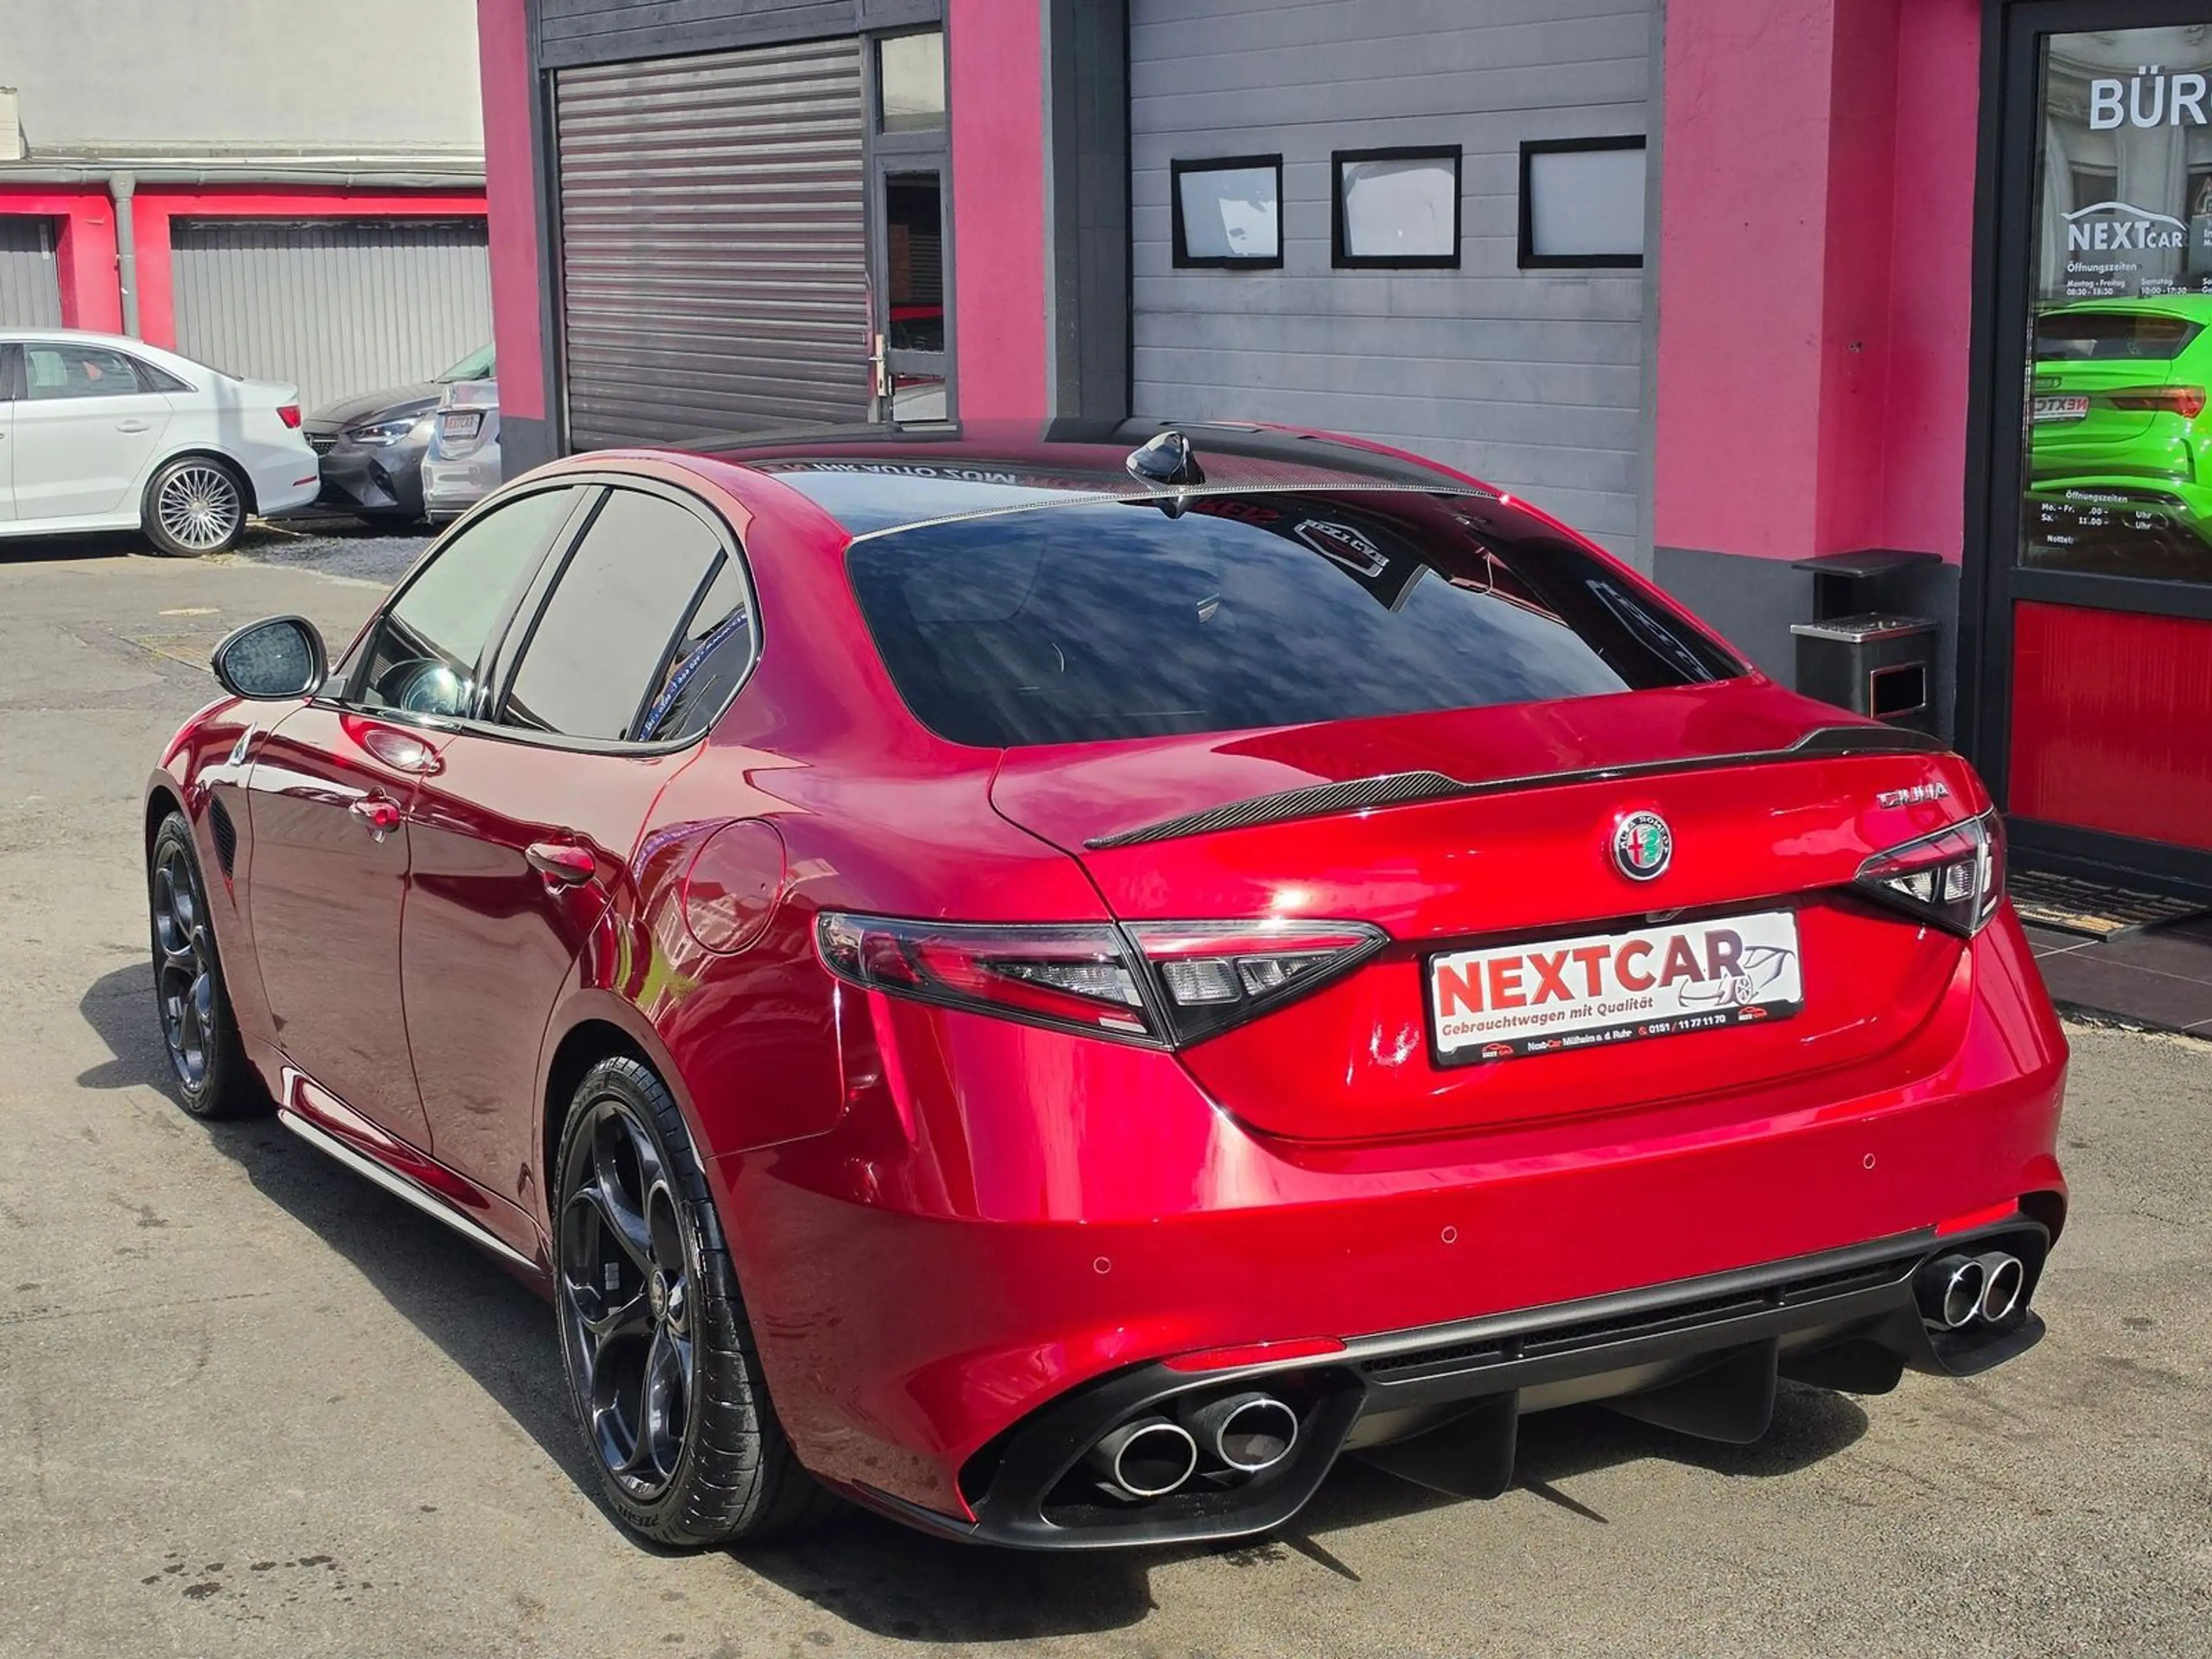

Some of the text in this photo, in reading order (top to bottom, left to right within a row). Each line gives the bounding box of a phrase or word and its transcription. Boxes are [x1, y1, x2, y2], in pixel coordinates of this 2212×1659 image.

[2090, 65, 2212, 130] BÜR
[2067, 260, 2137, 273] Öffnungszeiten
[2067, 280, 2093, 288] Montag
[2100, 279, 2126, 288] Freitag
[2141, 278, 2173, 286] Samstag
[2066, 490, 2128, 502] Öffnungszeiten
[2135, 511, 2152, 519] Uhr
[2135, 521, 2152, 530] Uhr
[1437, 928, 1746, 1017] NEXTCAR
[1441, 996, 1654, 1037] Gebrauchtwagen mit Qualität
